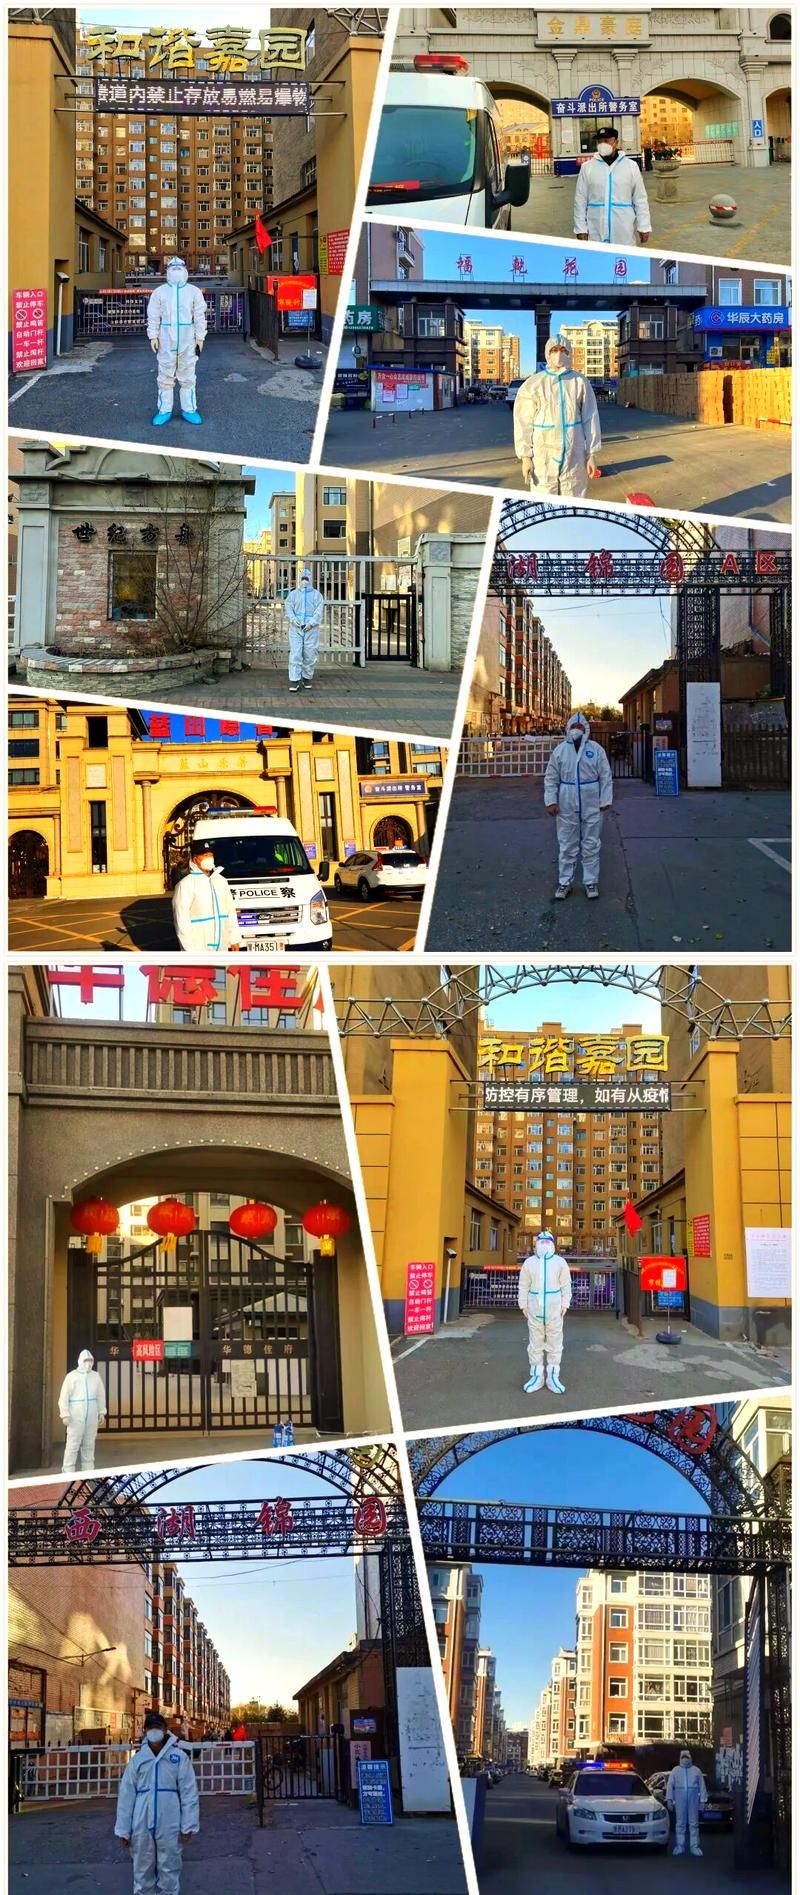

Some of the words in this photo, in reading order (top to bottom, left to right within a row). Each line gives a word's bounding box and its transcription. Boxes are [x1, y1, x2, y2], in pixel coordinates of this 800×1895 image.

[87, 24, 308, 73] 和谐嘉园
[556, 101, 638, 113] 奋斗派出所警务室
[754, 121, 762, 136] 入口
[456, 255, 627, 276] 福乾花园
[727, 311, 784, 324] 华辰大药房
[72, 521, 195, 546] 世纪方舟
[239, 889, 278, 897] POLICE
[280, 887, 296, 898] 察
[478, 1034, 670, 1075] 和谐嘉园
[136, 1344, 161, 1357] 高风险区
